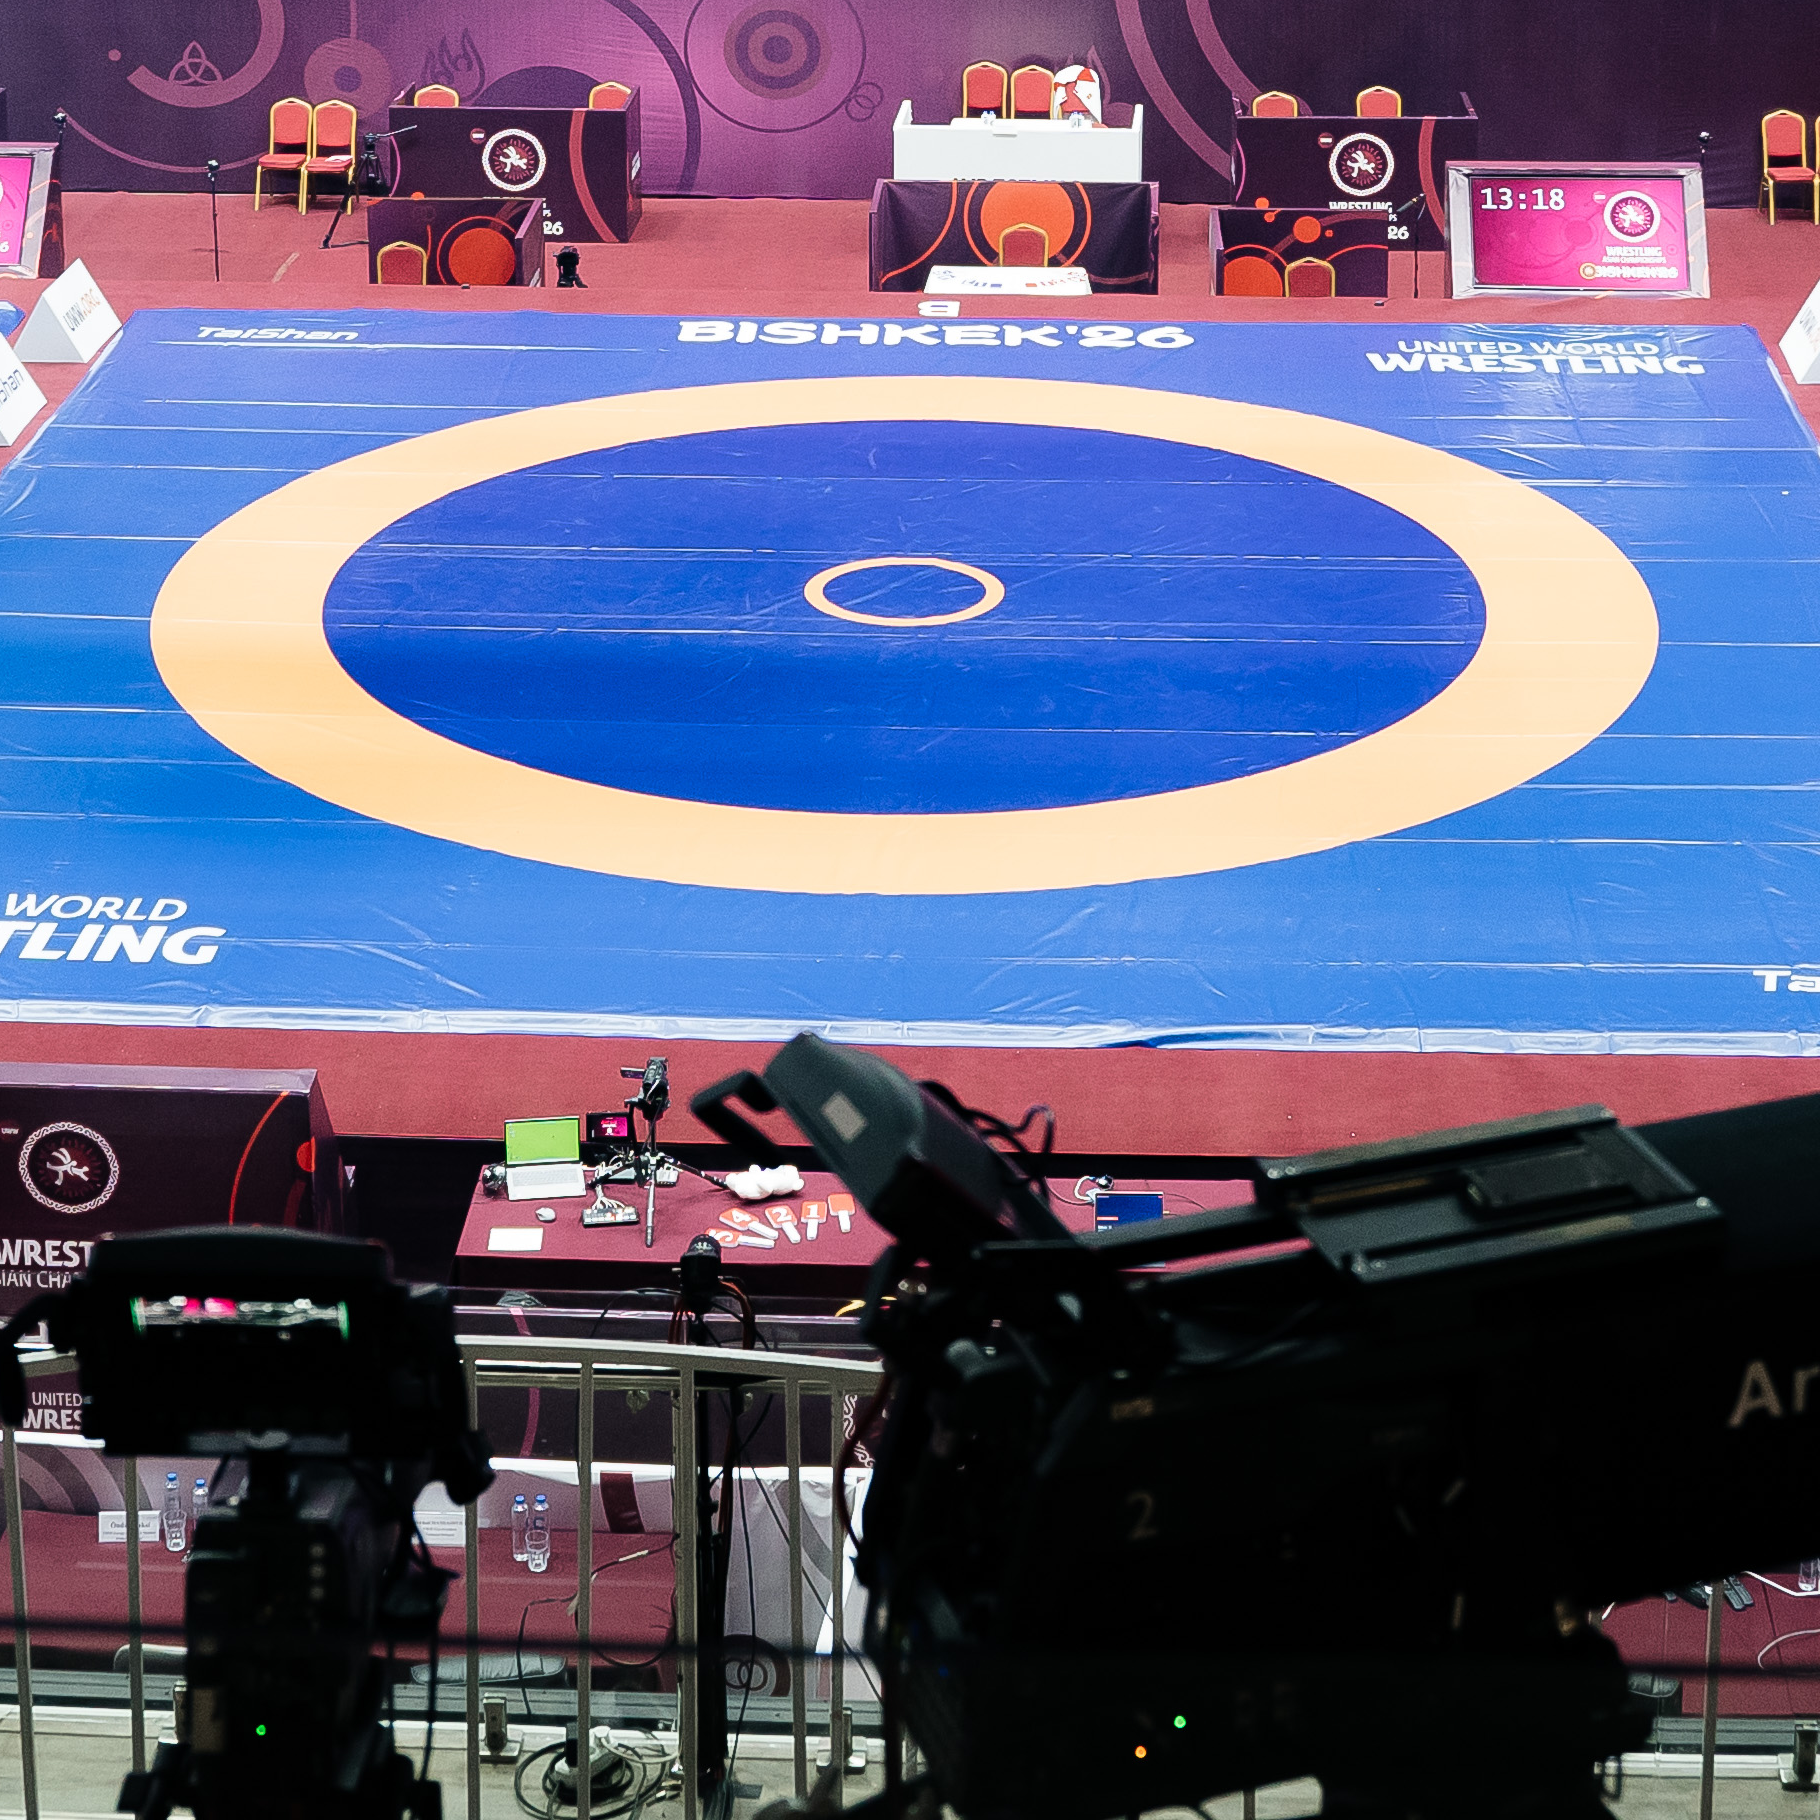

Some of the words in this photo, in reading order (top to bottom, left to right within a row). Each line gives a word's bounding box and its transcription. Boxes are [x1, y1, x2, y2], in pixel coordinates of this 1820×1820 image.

[1480, 187, 1566, 210] 13:18
[1606, 246, 1663, 257] WRESTLING
[196, 326, 359, 342] TaiShan
[677, 320, 1198, 353] BISHKEK'26
[1399, 340, 1507, 357] UNITED
[1514, 342, 1659, 357] WORLD
[1366, 351, 1706, 376] WRESTLING
[4, 890, 190, 922] WORLD
[732, 1208, 752, 1223] 4
[772, 1207, 792, 1222] 2
[806, 1204, 820, 1218] 1
[32, 1392, 83, 1407] UNITED
[1126, 1491, 1159, 1541] 2
